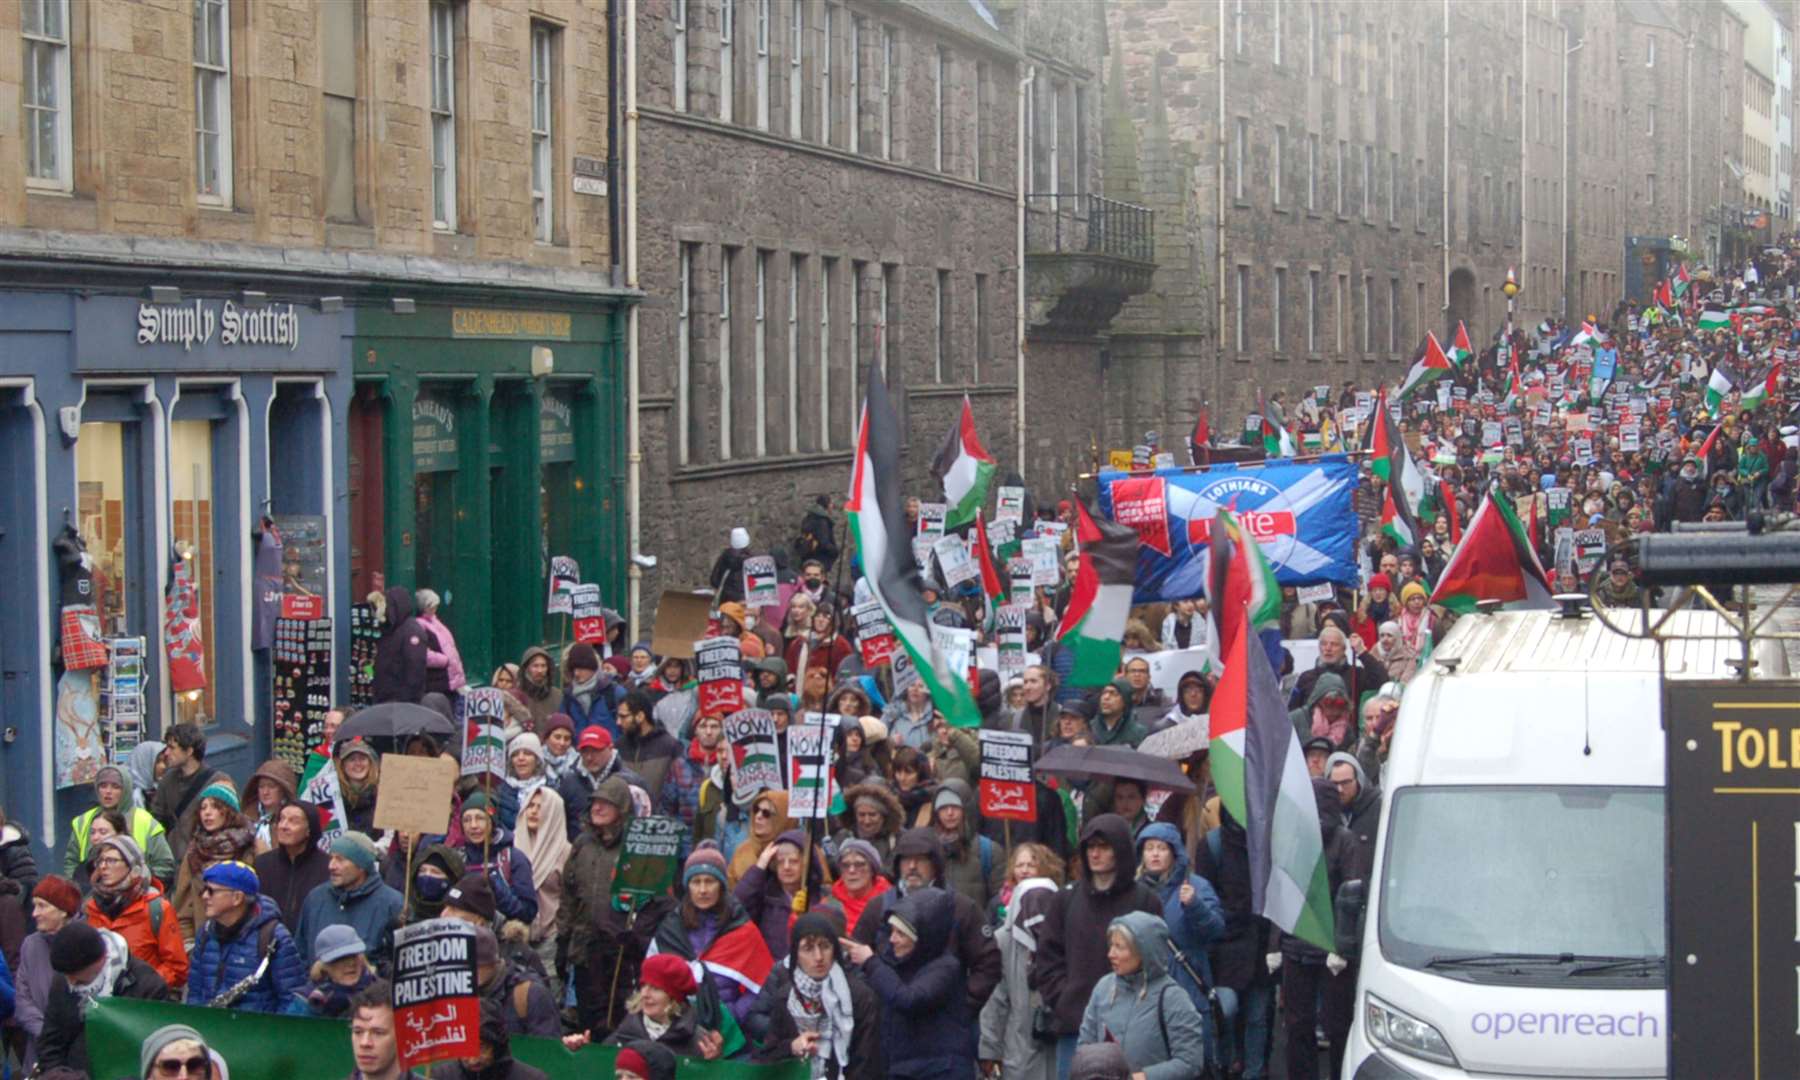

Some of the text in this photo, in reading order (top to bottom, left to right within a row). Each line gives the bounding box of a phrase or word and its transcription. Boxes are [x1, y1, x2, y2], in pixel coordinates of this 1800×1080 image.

[137, 298, 299, 351] Simply Scottish
[1206, 480, 1269, 501] LOTHIANS
[625, 843, 678, 856] YEMEN
[397, 937, 468, 971] FREEDOM
[394, 970, 474, 1006] PALESTINE
[405, 1003, 458, 1033] الحرية
[1471, 1010, 1659, 1040] openreach
[403, 1024, 467, 1059] لفلسطين
